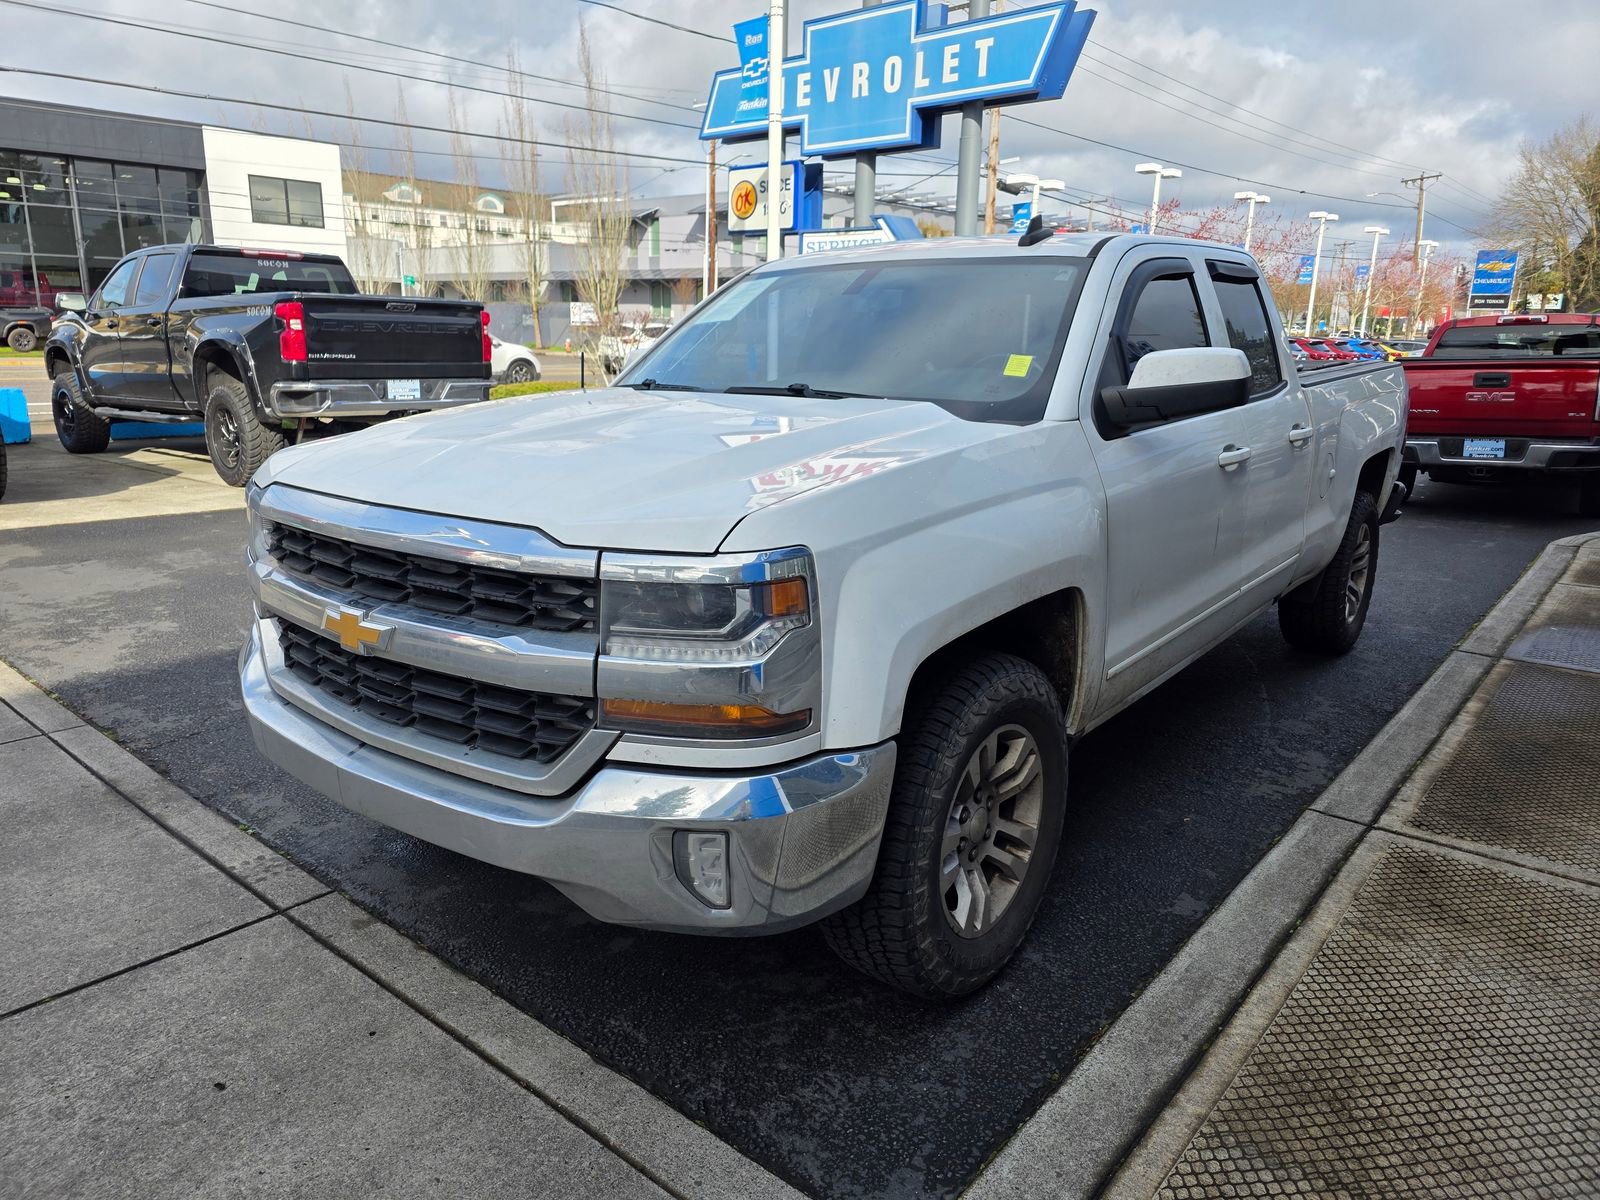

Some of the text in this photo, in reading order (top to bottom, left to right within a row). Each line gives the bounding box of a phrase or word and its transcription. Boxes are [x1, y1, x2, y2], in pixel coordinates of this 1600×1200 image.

[745, 33, 763, 47] Ron
[781, 37, 994, 110] EVROLET
[738, 96, 768, 110] Tonkin
[735, 188, 753, 213] OK
[1465, 391, 1516, 401] GMC
